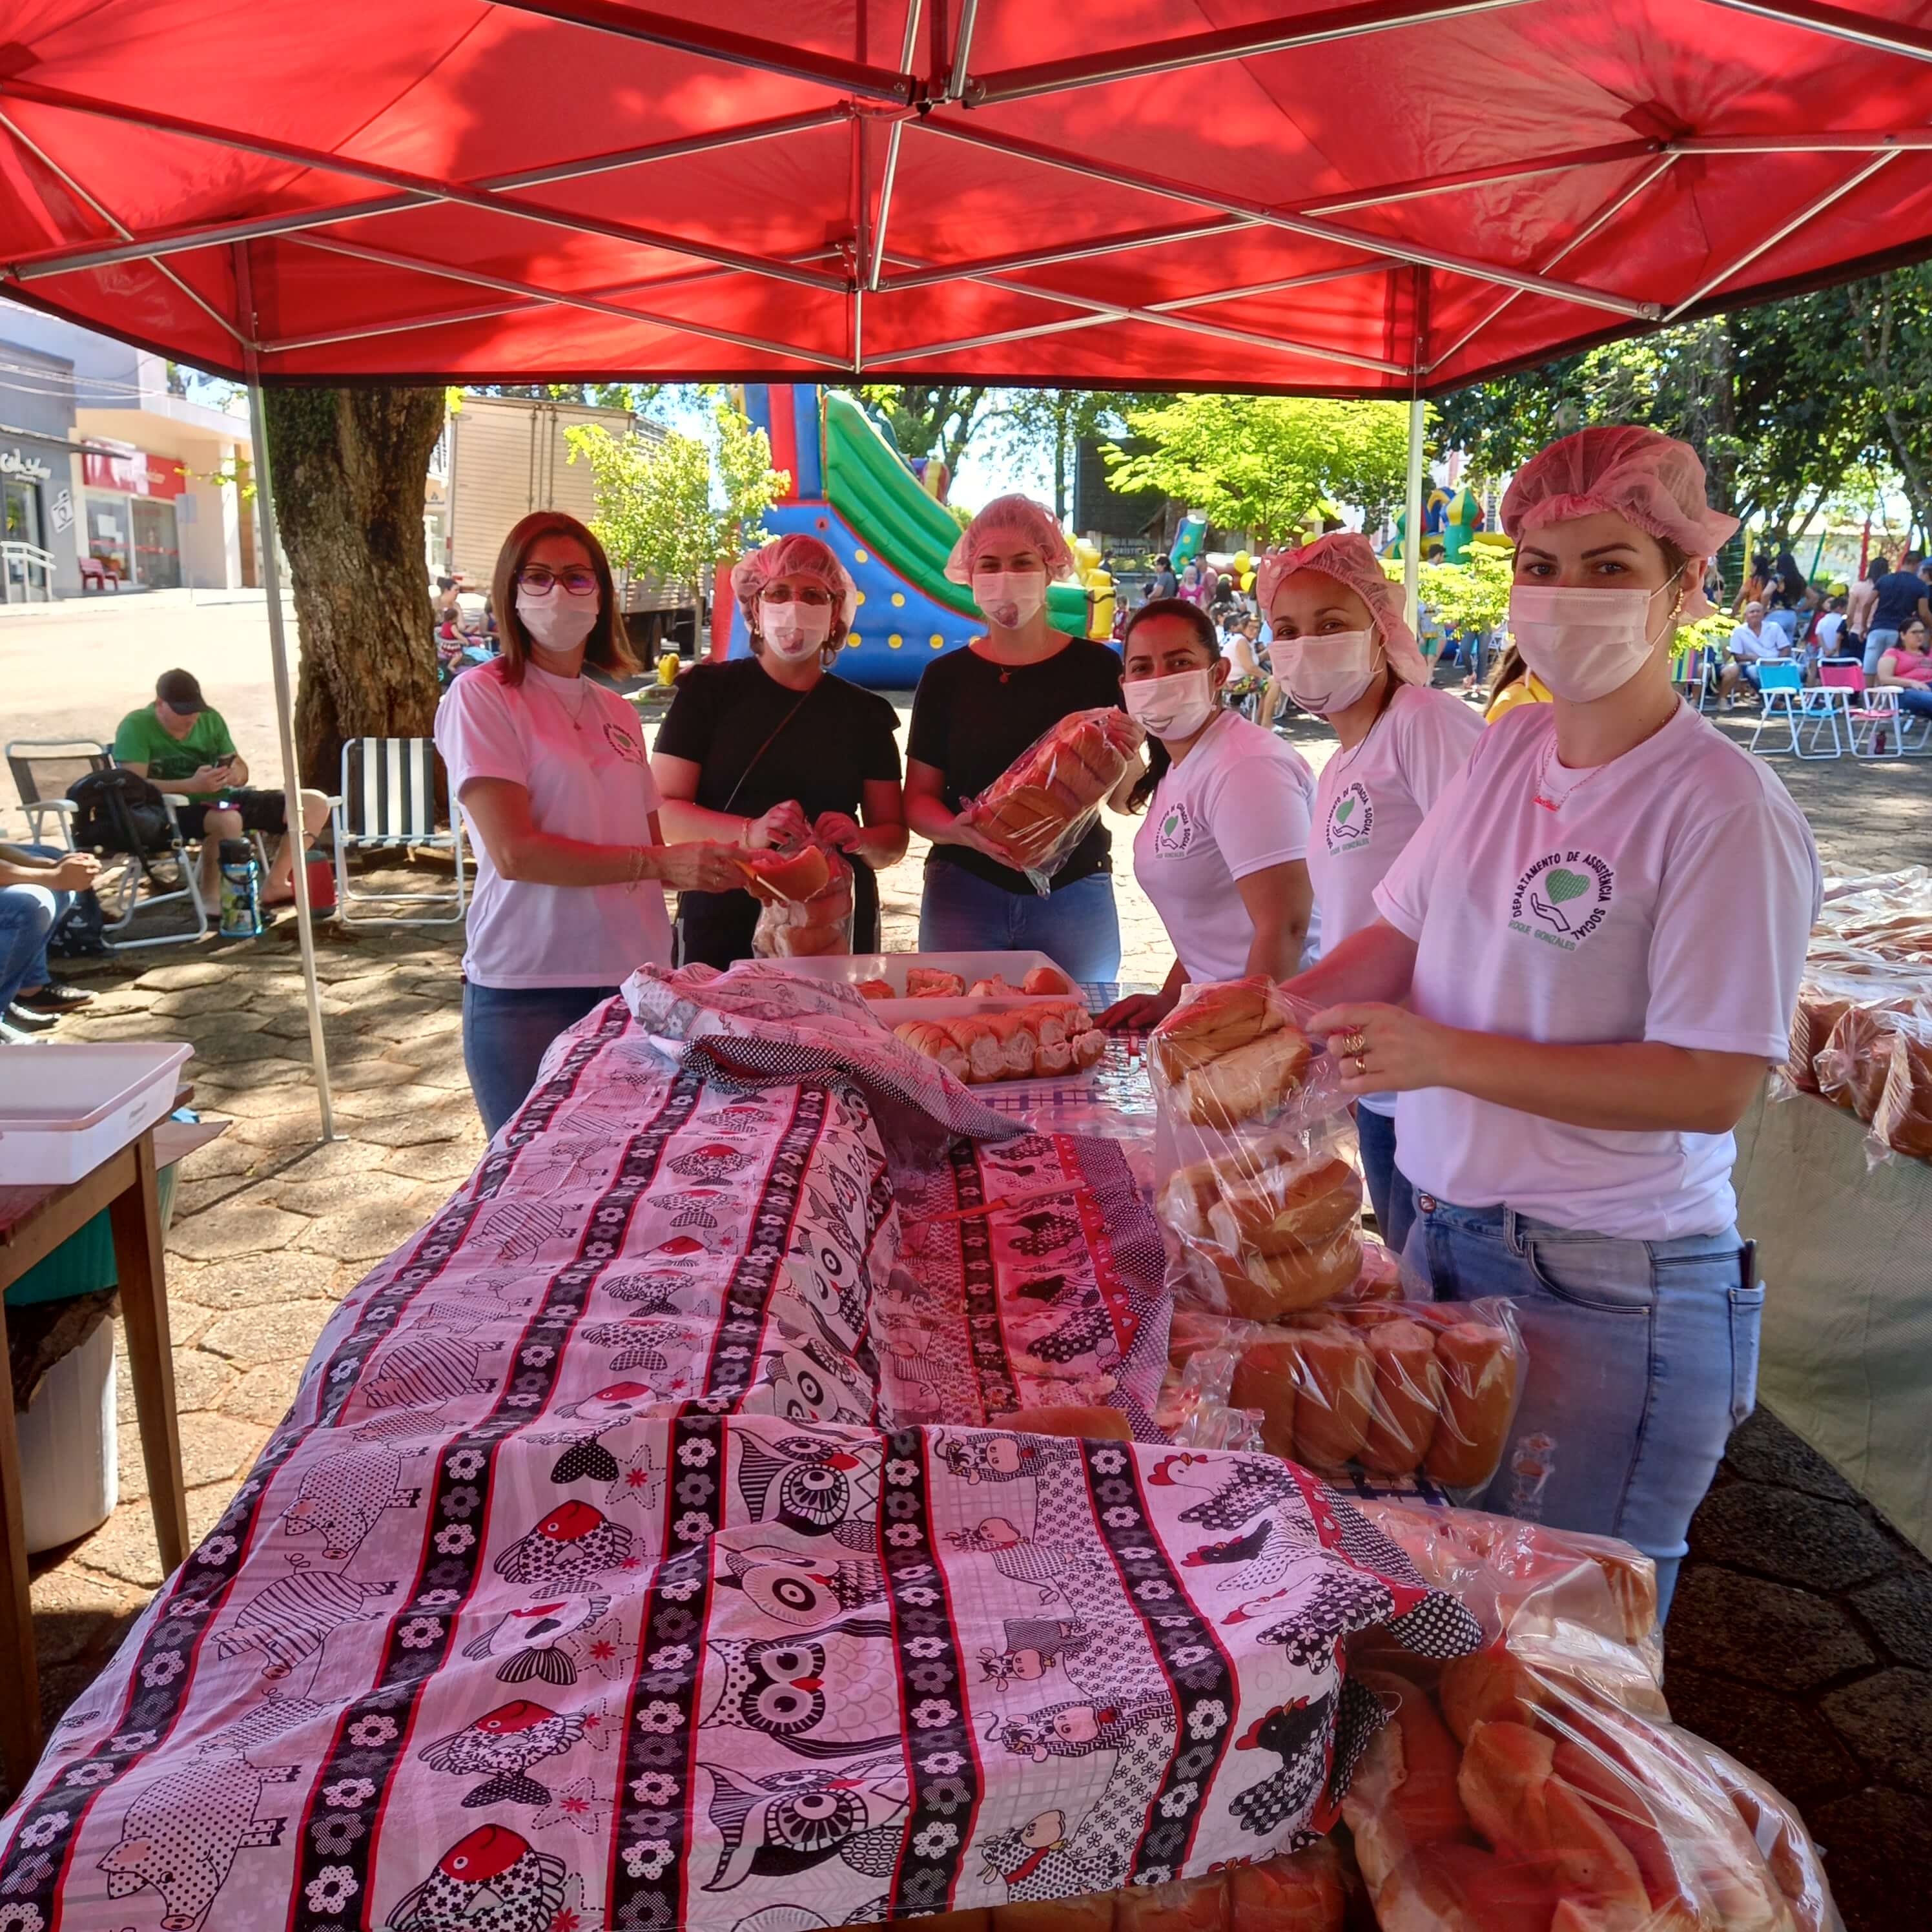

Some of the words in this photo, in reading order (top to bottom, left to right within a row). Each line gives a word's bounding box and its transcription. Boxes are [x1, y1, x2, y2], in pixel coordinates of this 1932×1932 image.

[1361, 807, 1373, 835] SOCIAL
[1566, 852, 1580, 862] DE
[1512, 853, 1561, 918] DEPARTAMENTO
[1582, 854, 1614, 902] ASSISTÊNCIA
[1570, 907, 1606, 940] SOCIAL
[1534, 929, 1576, 951] GONZALES
